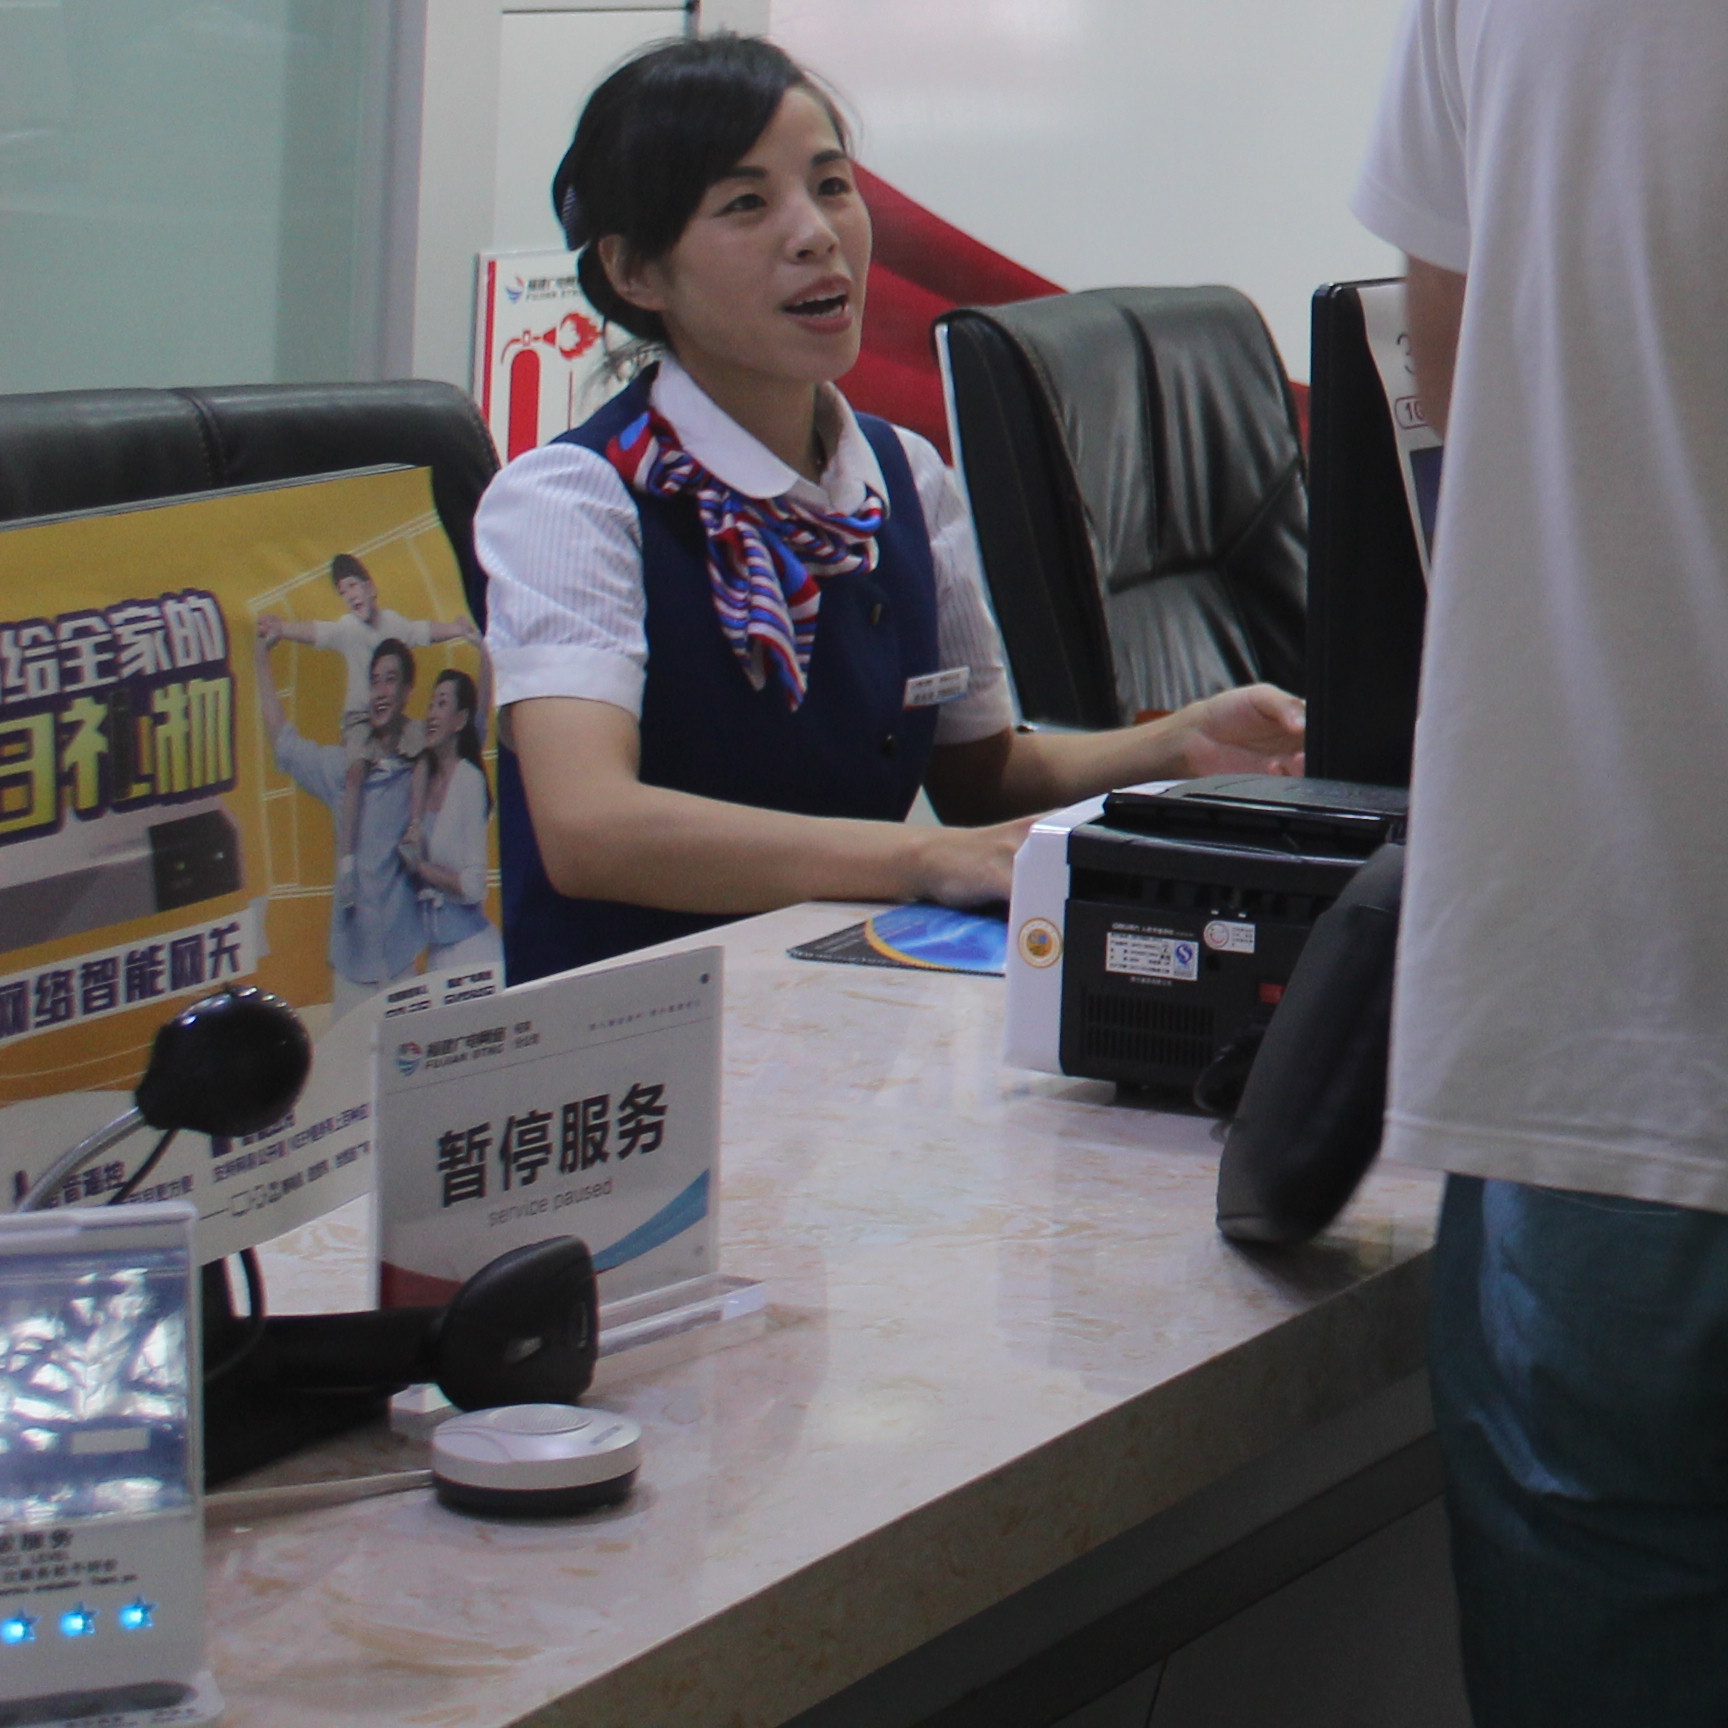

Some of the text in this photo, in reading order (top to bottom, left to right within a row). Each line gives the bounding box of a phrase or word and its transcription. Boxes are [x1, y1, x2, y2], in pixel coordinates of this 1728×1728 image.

[0, 593, 228, 705] 给全家的
[436, 1082, 669, 1209] 暂停服务
[488, 1176, 614, 1227] service paused
